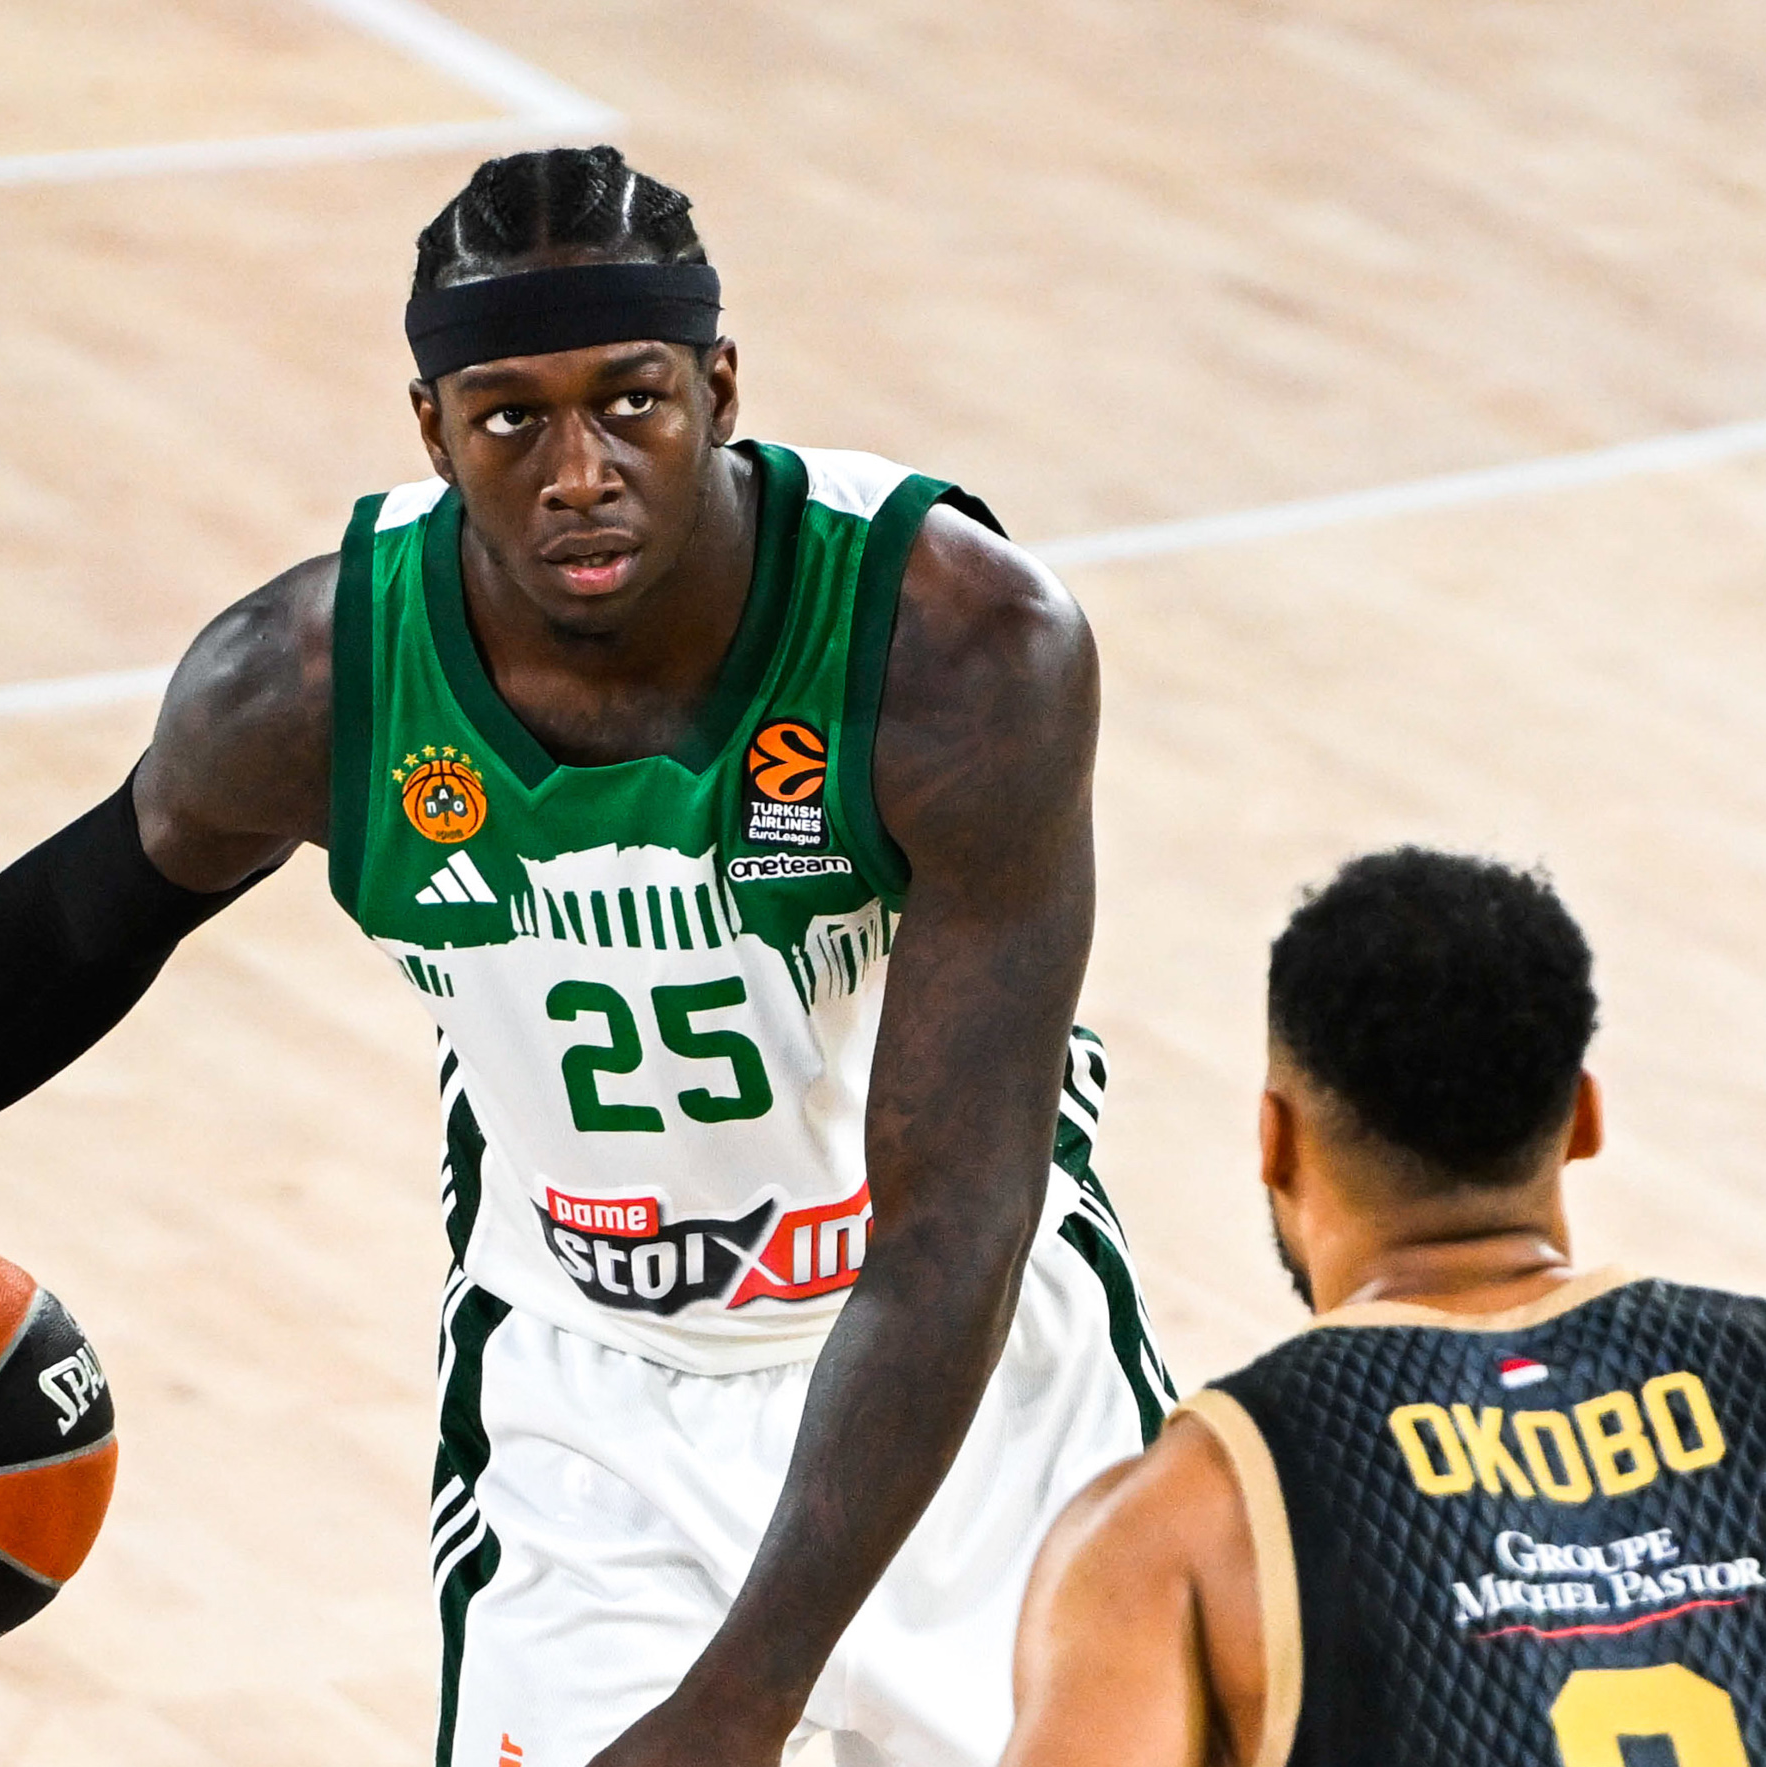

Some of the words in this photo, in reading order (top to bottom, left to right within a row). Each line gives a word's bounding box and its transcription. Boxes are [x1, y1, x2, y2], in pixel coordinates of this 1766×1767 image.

[749, 815, 821, 832] AIRLINES
[751, 802, 822, 819] TURKISH
[748, 828, 821, 845] EuroLeague
[730, 855, 850, 879] oneteam
[546, 975, 774, 1133] 25
[554, 1195, 648, 1231] pame
[1389, 1370, 1727, 1504] OKOBO
[1494, 1527, 1680, 1576] GROUPE
[1452, 1573, 1611, 1627] MICHEL
